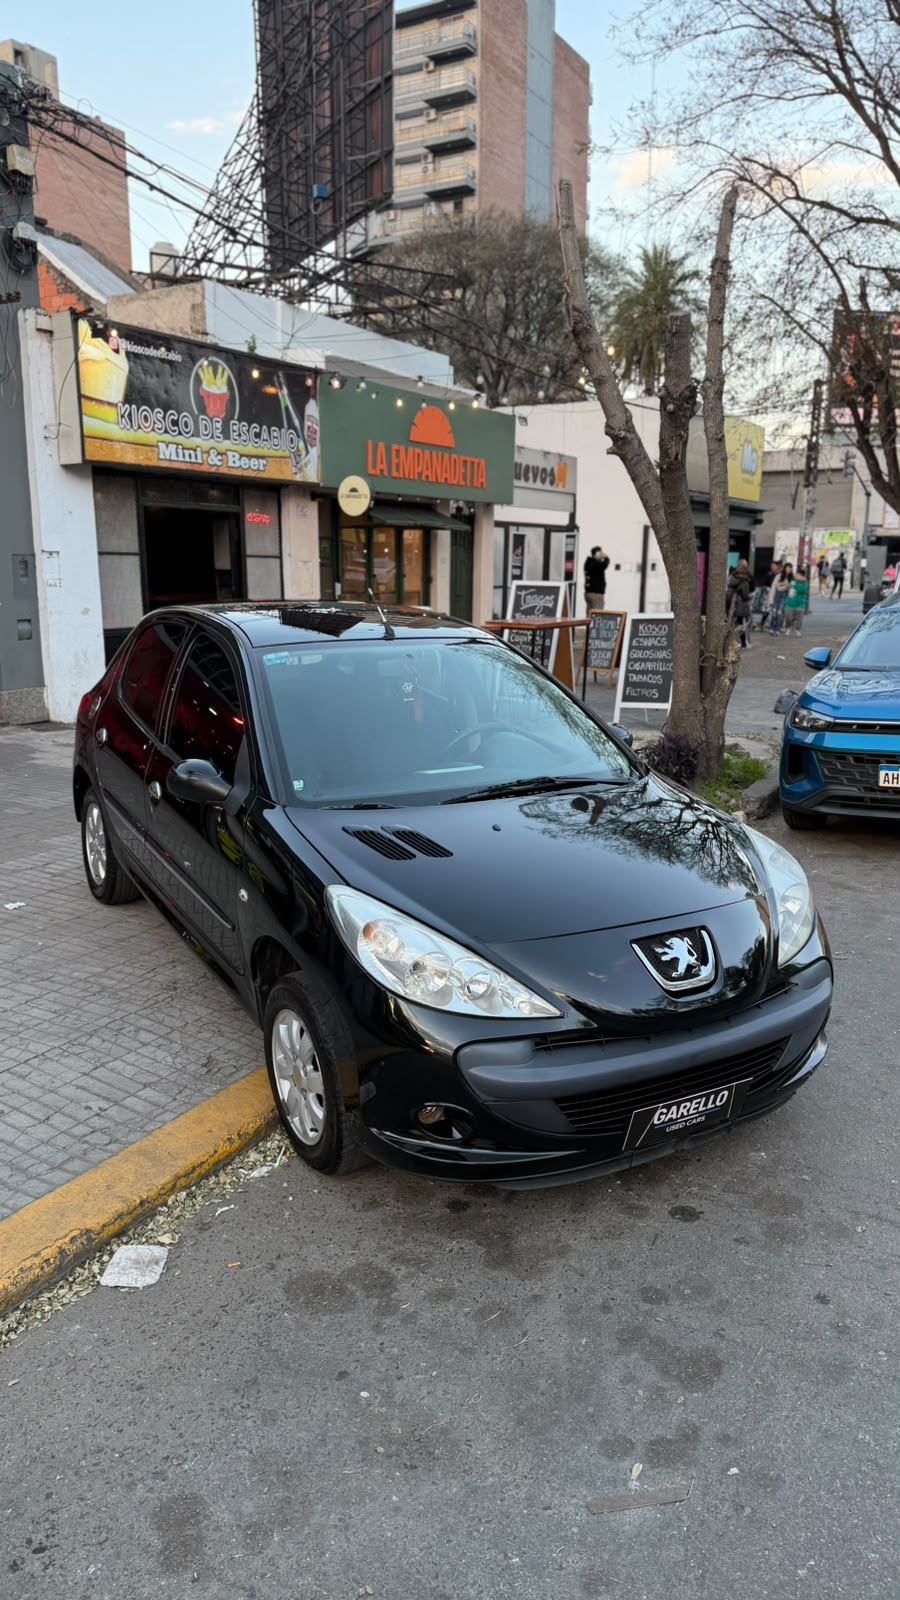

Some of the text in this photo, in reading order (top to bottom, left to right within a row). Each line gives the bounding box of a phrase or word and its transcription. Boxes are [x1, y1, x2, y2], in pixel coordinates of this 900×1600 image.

[119, 338, 182, 362] @kioscodeescabio
[117, 402, 194, 438] KIOSCO
[199, 415, 223, 442] DE
[229, 420, 298, 452] ESCABIO
[157, 441, 267, 471] Mini & Beer
[367, 439, 488, 489] LA EMPANADETTA
[883, 772, 900, 785] AH
[653, 1090, 729, 1125] GARELLO
[666, 1115, 706, 1133] USED CARS
